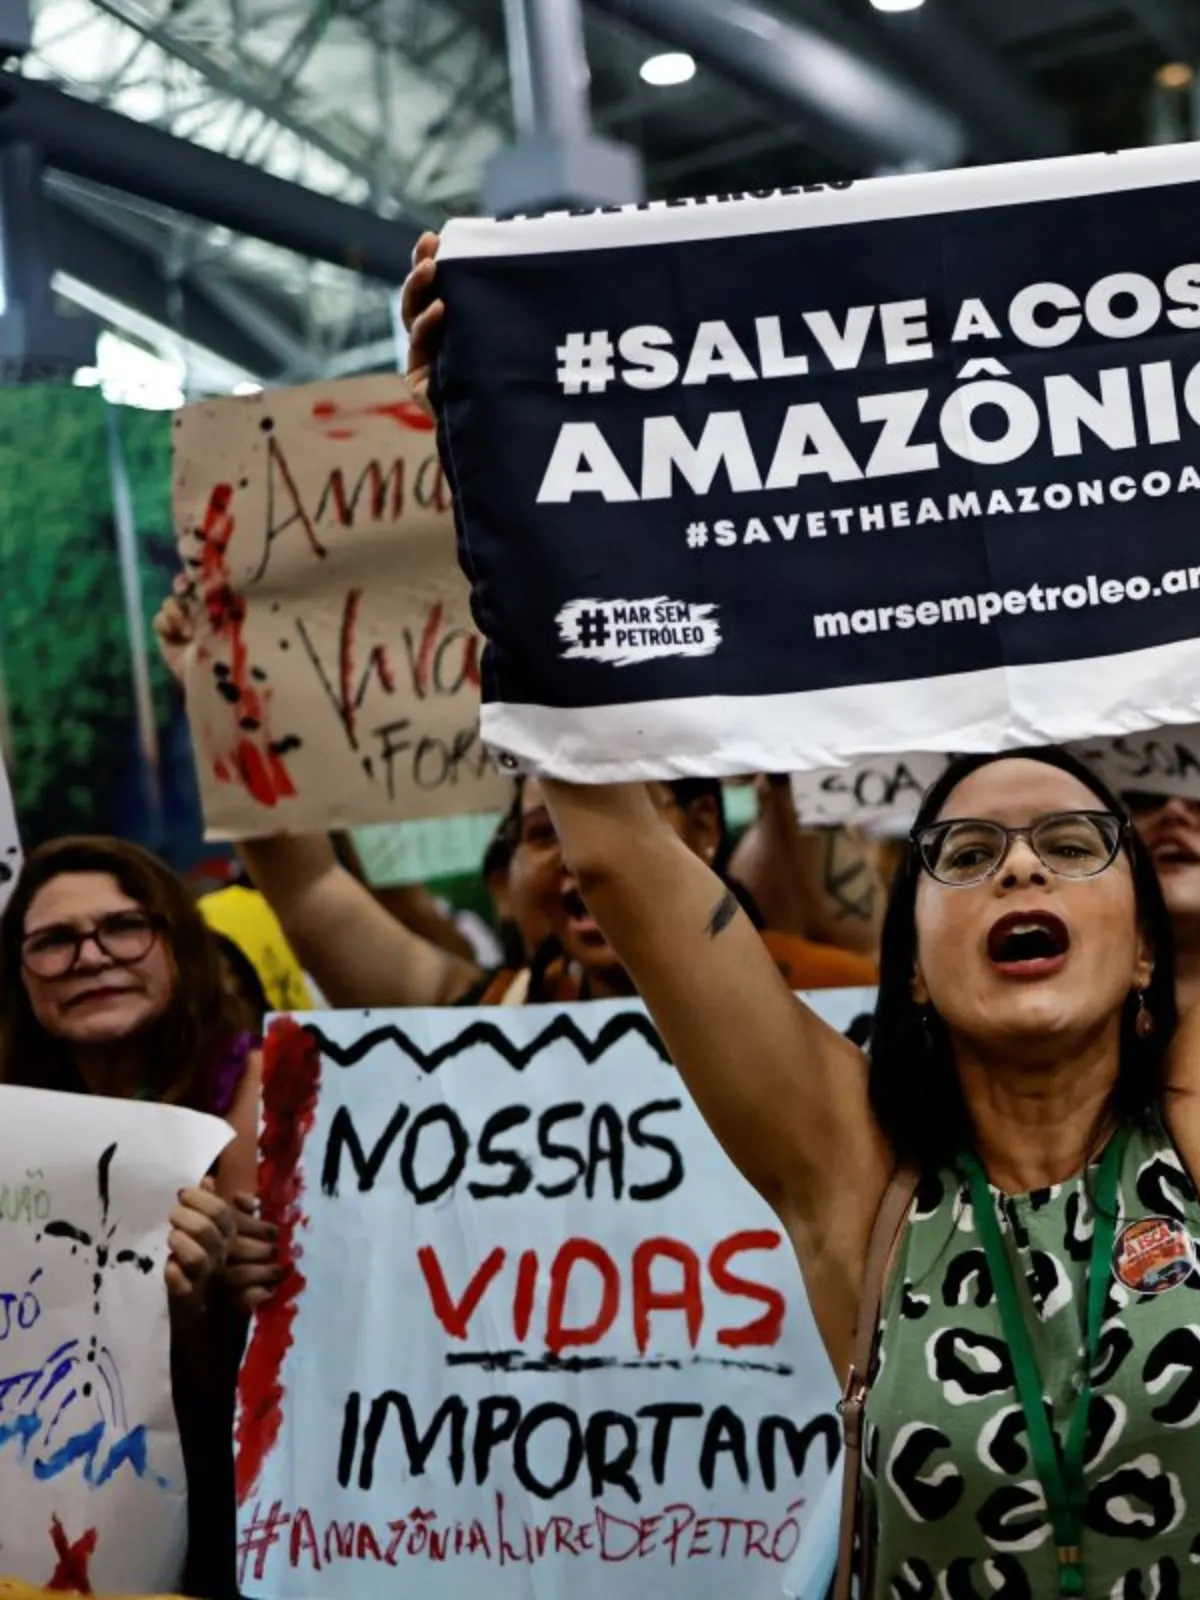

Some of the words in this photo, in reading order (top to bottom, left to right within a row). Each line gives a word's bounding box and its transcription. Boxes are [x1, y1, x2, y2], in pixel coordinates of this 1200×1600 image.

[556, 299, 934, 394] #SALVE
[951, 298, 1002, 342] A
[615, 626, 705, 648] PETRÓLEO
[654, 605, 691, 623] SEM
[320, 1099, 685, 1204] NOSSAS
[418, 1229, 785, 1357] VIDAS
[337, 1389, 843, 1503] IMPORTAM
